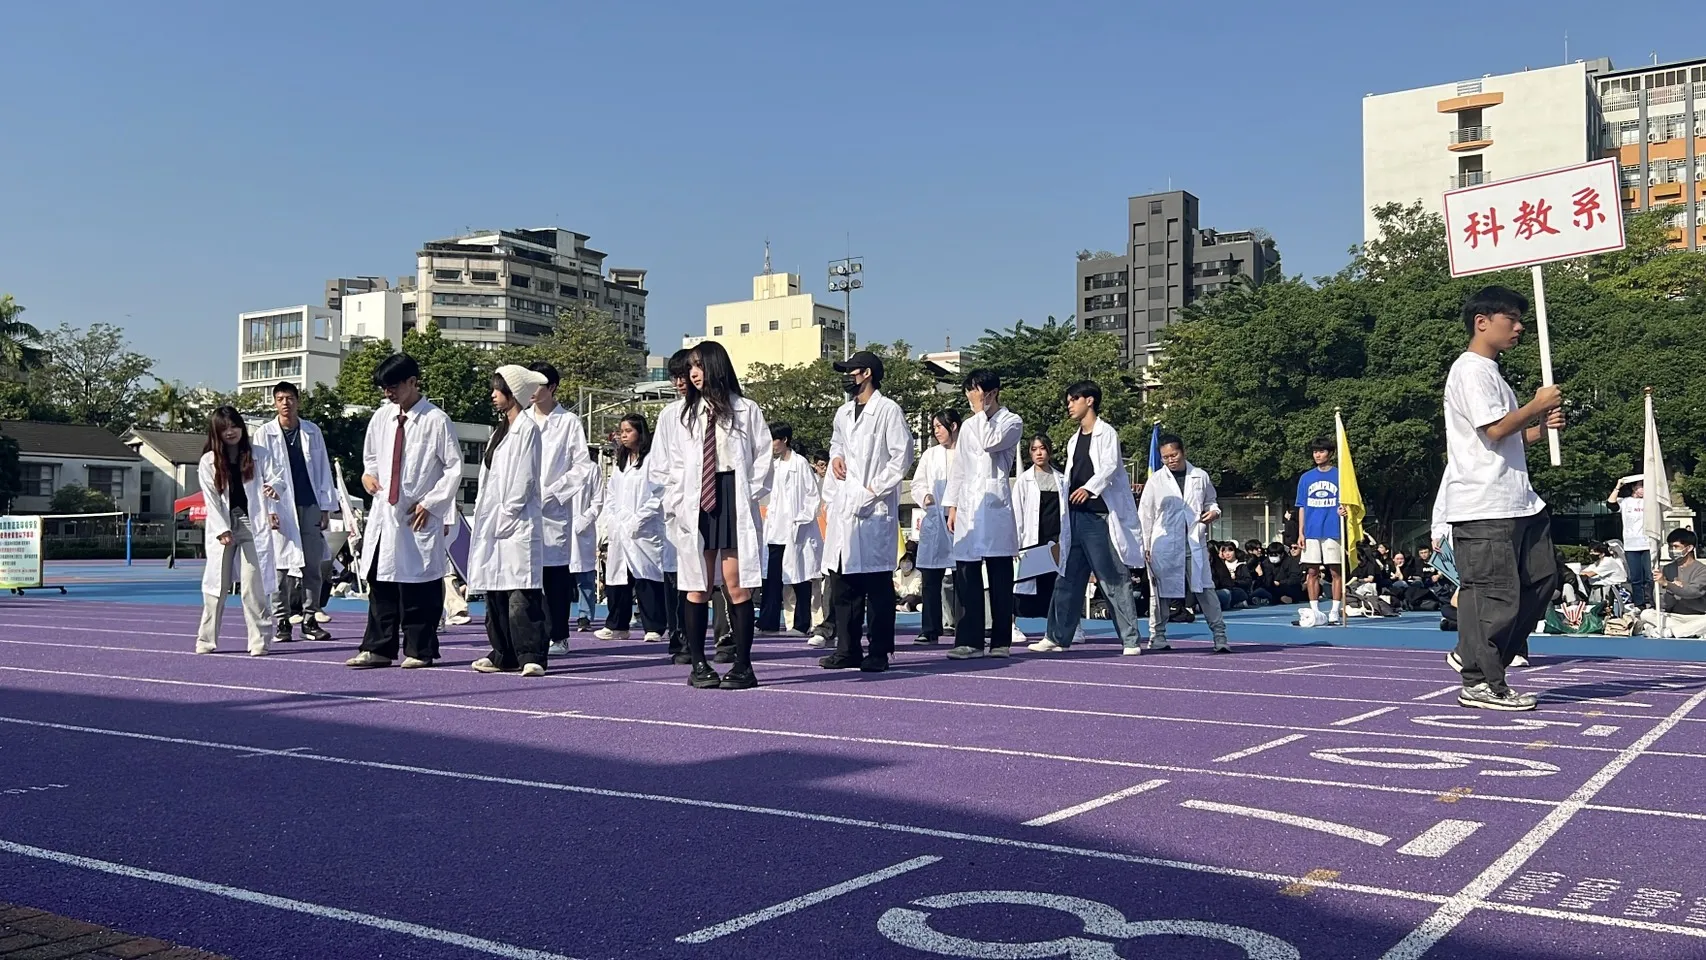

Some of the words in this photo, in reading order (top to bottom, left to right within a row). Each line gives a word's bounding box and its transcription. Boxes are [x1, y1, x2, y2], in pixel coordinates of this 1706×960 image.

[1464, 187, 1606, 249] 科教系
[1410, 715, 1622, 737] 5
[1309, 747, 1561, 777] 6
[1180, 799, 1484, 858] 7
[877, 890, 1302, 960] 8
